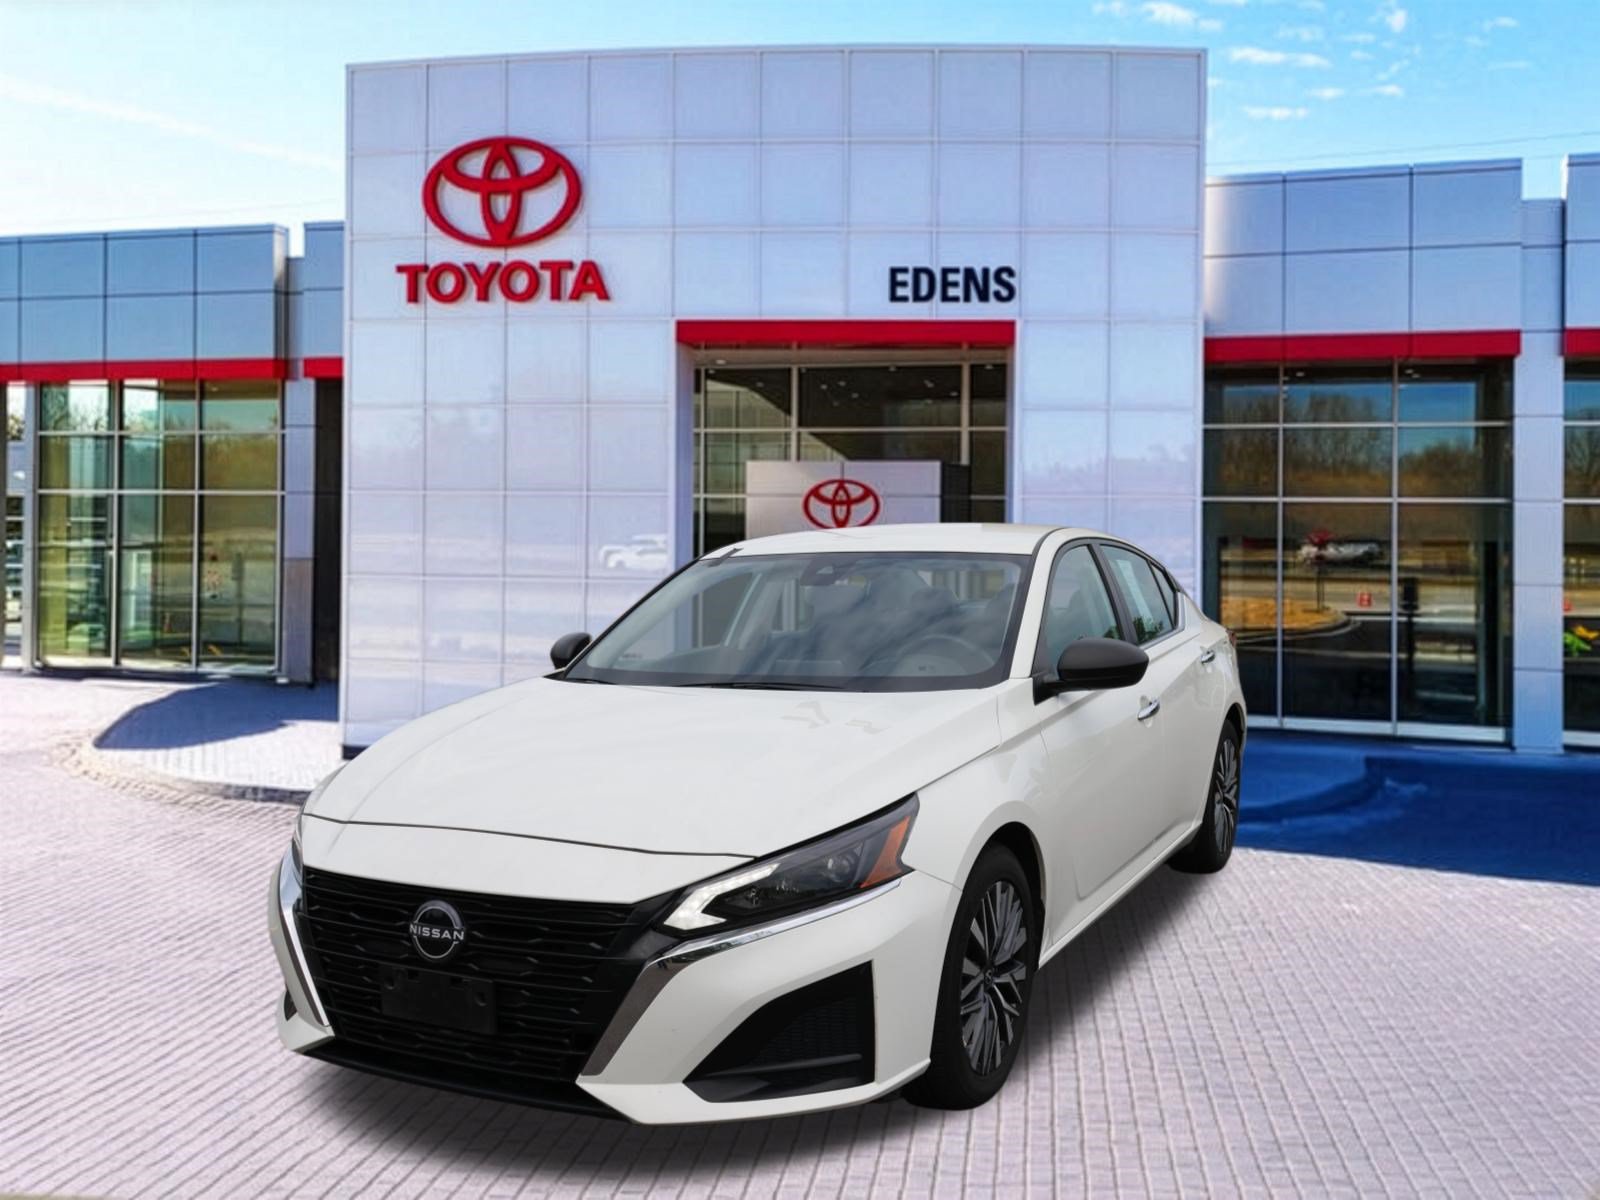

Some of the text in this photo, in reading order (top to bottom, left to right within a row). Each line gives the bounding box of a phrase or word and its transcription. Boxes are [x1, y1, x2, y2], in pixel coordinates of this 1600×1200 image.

[396, 260, 611, 304] TOYOTA
[889, 266, 1017, 303] EDENS
[409, 924, 465, 940] NISSAN
